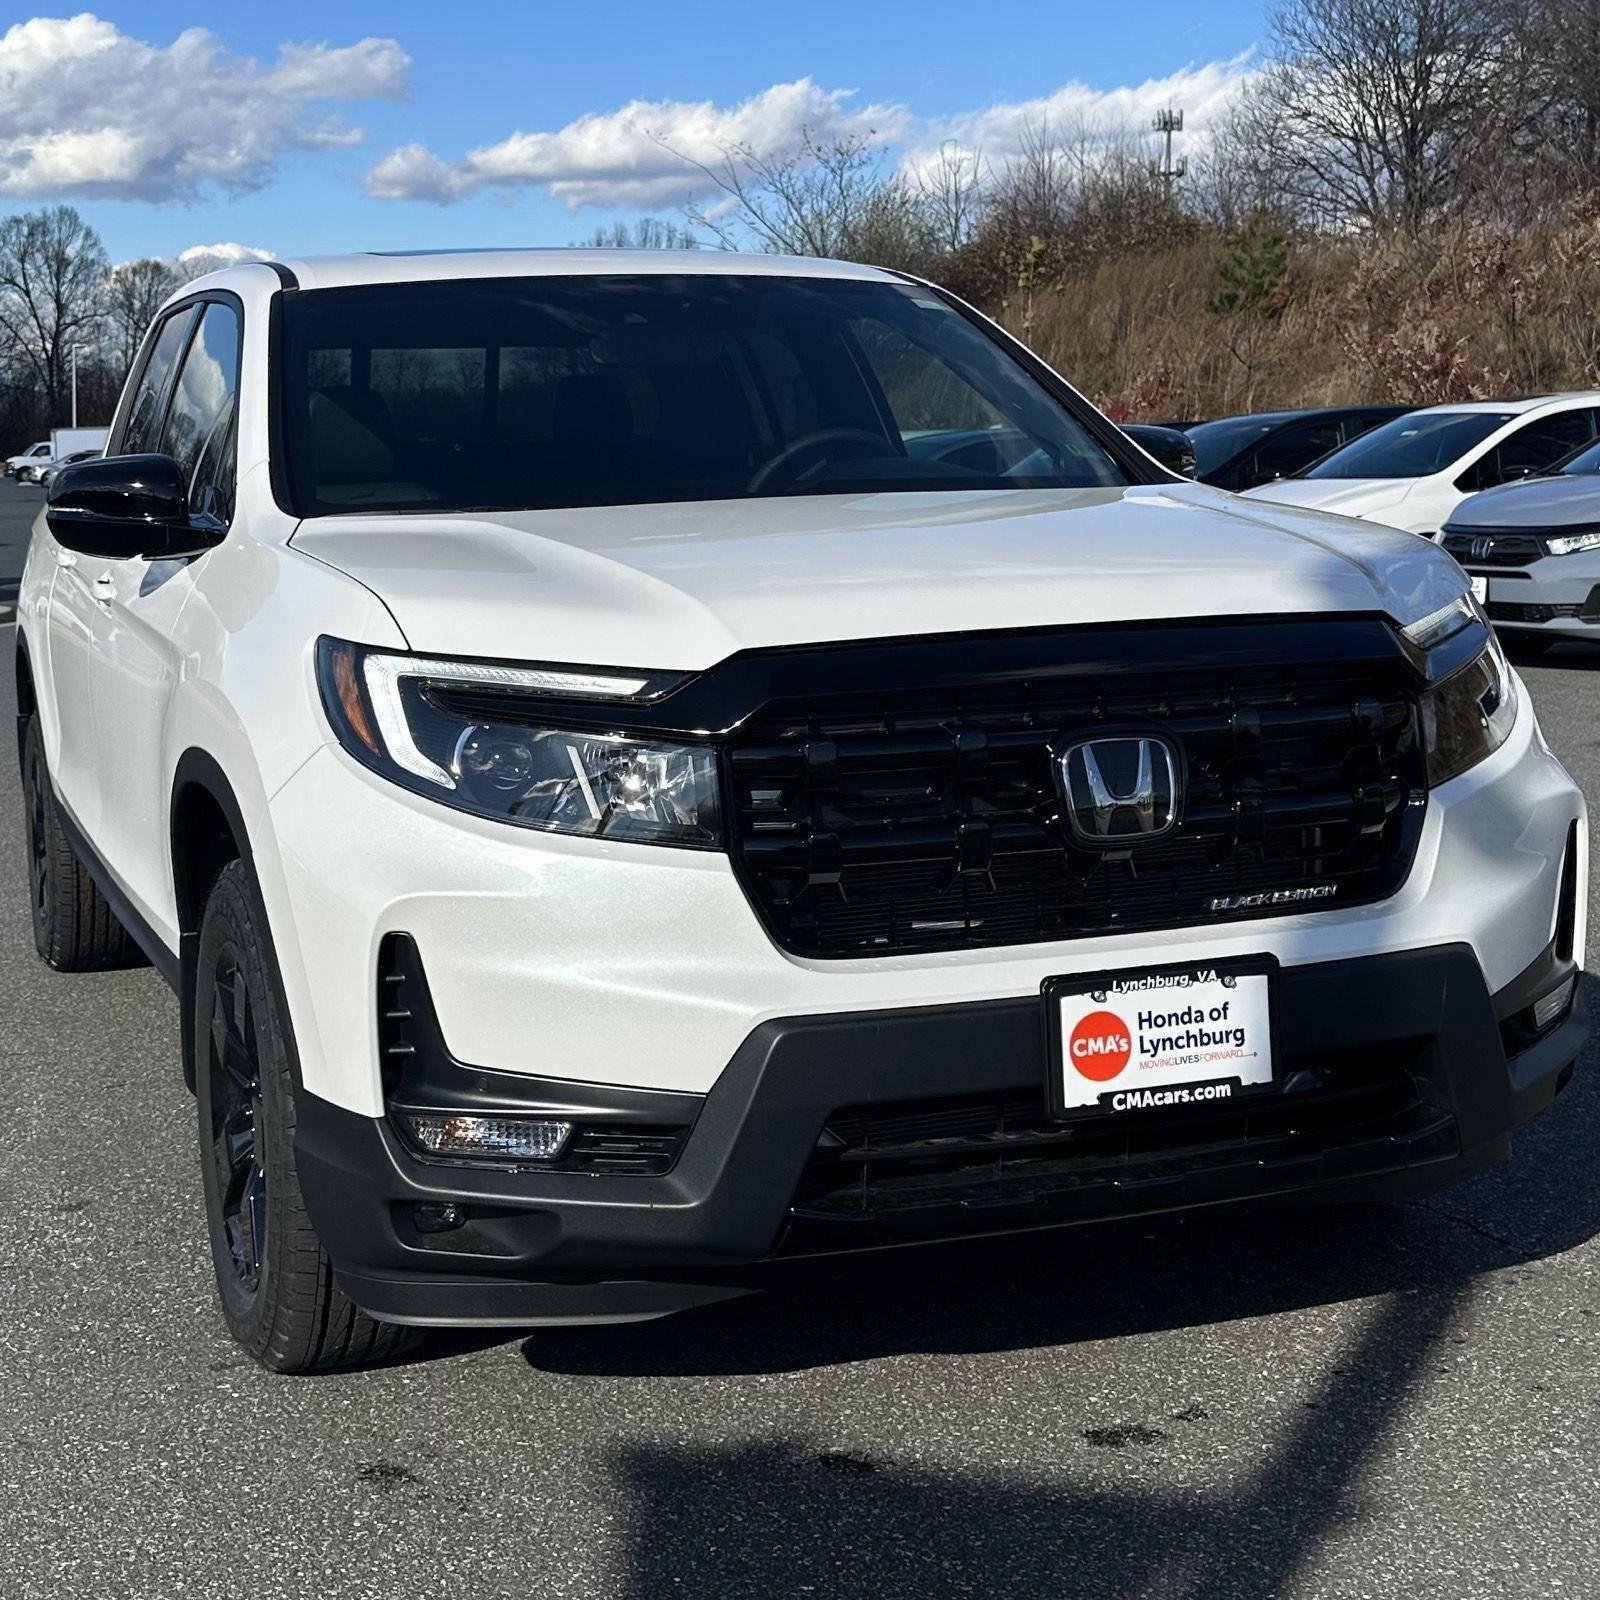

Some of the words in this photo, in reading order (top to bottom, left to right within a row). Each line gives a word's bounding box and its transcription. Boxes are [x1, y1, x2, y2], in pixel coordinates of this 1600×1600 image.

[1211, 893, 1273, 911] BLACK
[1272, 884, 1338, 903] EDITION
[1112, 974, 1193, 994] Lynchburg,
[1197, 969, 1218, 983] VA
[1138, 1005, 1204, 1030] Honda
[1208, 1001, 1229, 1022] of
[1072, 1034, 1129, 1058] CMA's
[1139, 1027, 1245, 1058] Lynchburg
[1112, 1083, 1231, 1111] CMAcars.com
